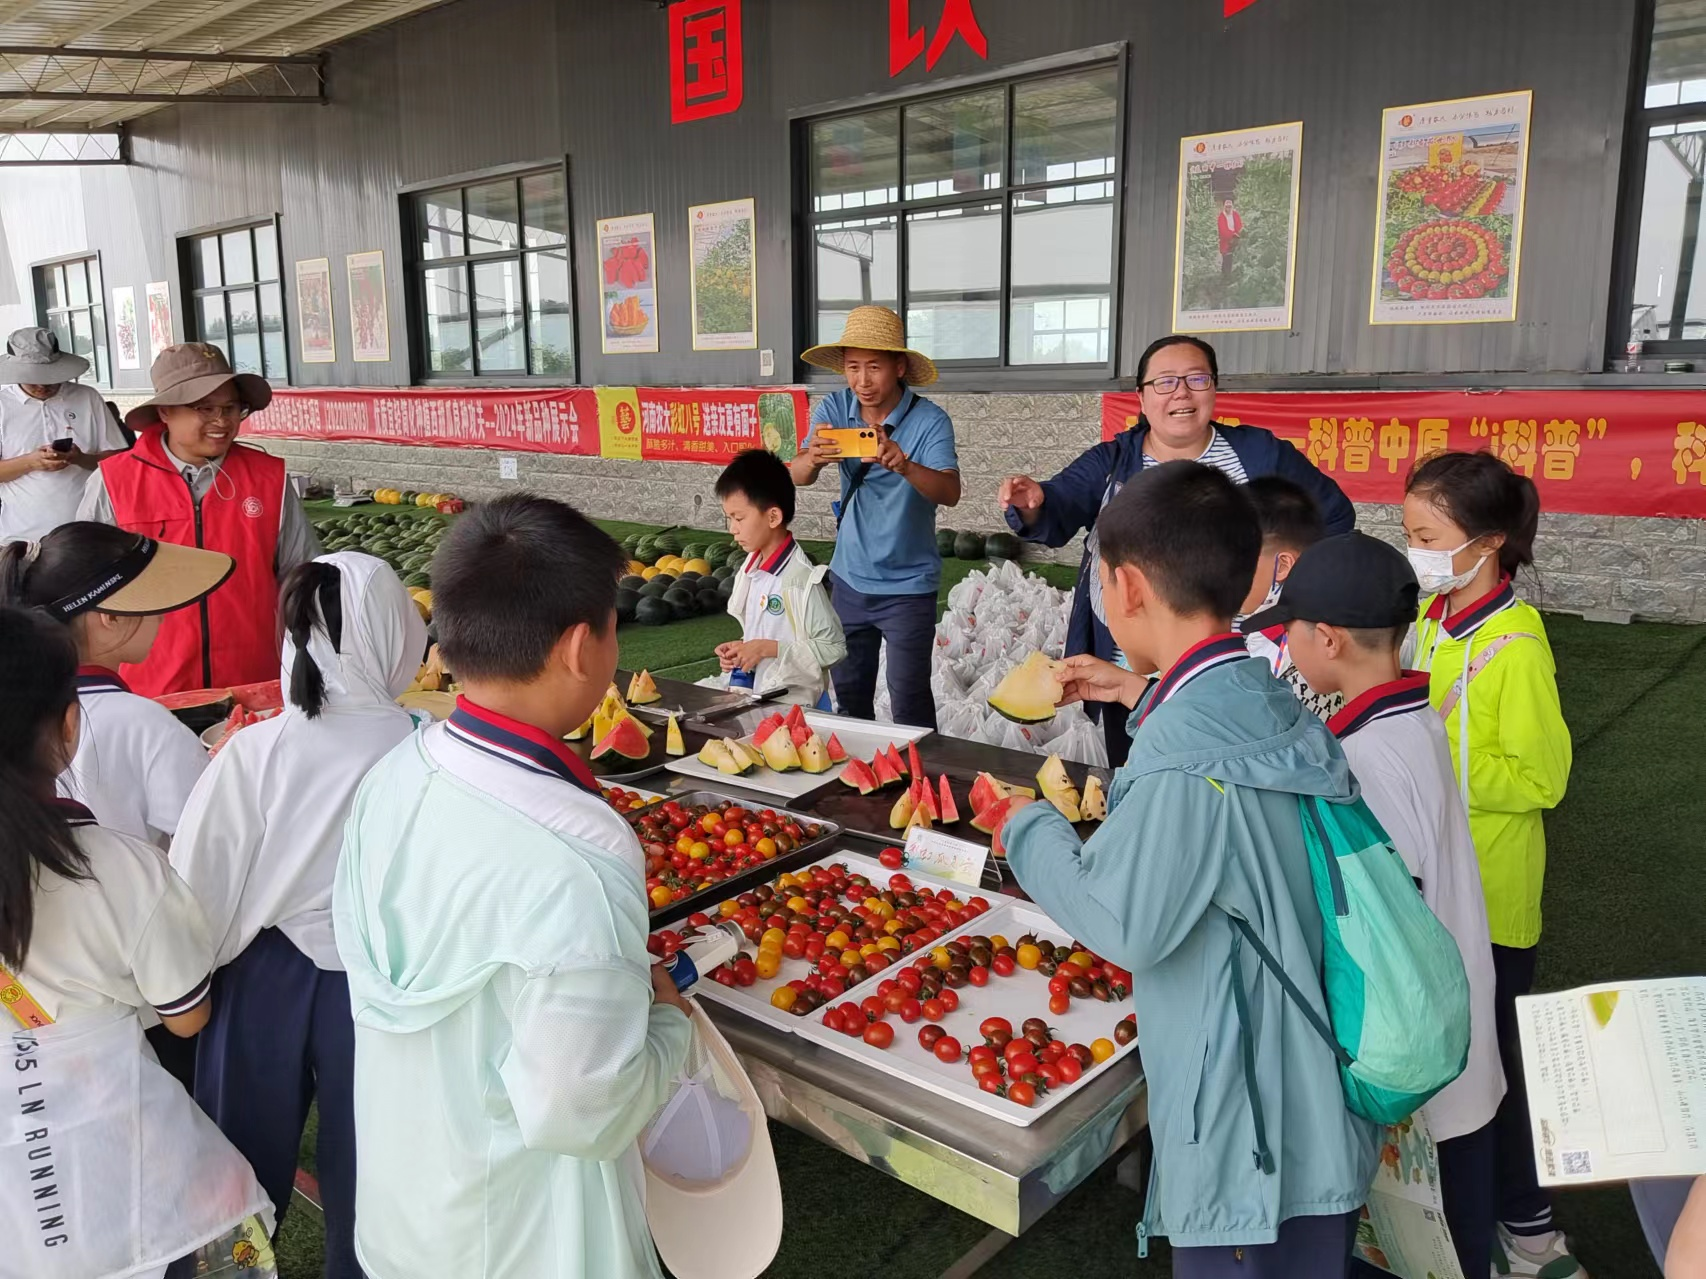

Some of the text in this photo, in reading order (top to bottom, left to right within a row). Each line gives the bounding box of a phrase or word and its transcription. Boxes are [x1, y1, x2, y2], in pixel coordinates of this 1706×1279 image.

[668, 0, 744, 124] 国
[62, 573, 123, 613] HELEN KAMINSKI
[18, 1081, 45, 1115] LN
[24, 1127, 68, 1248] RUNNING
